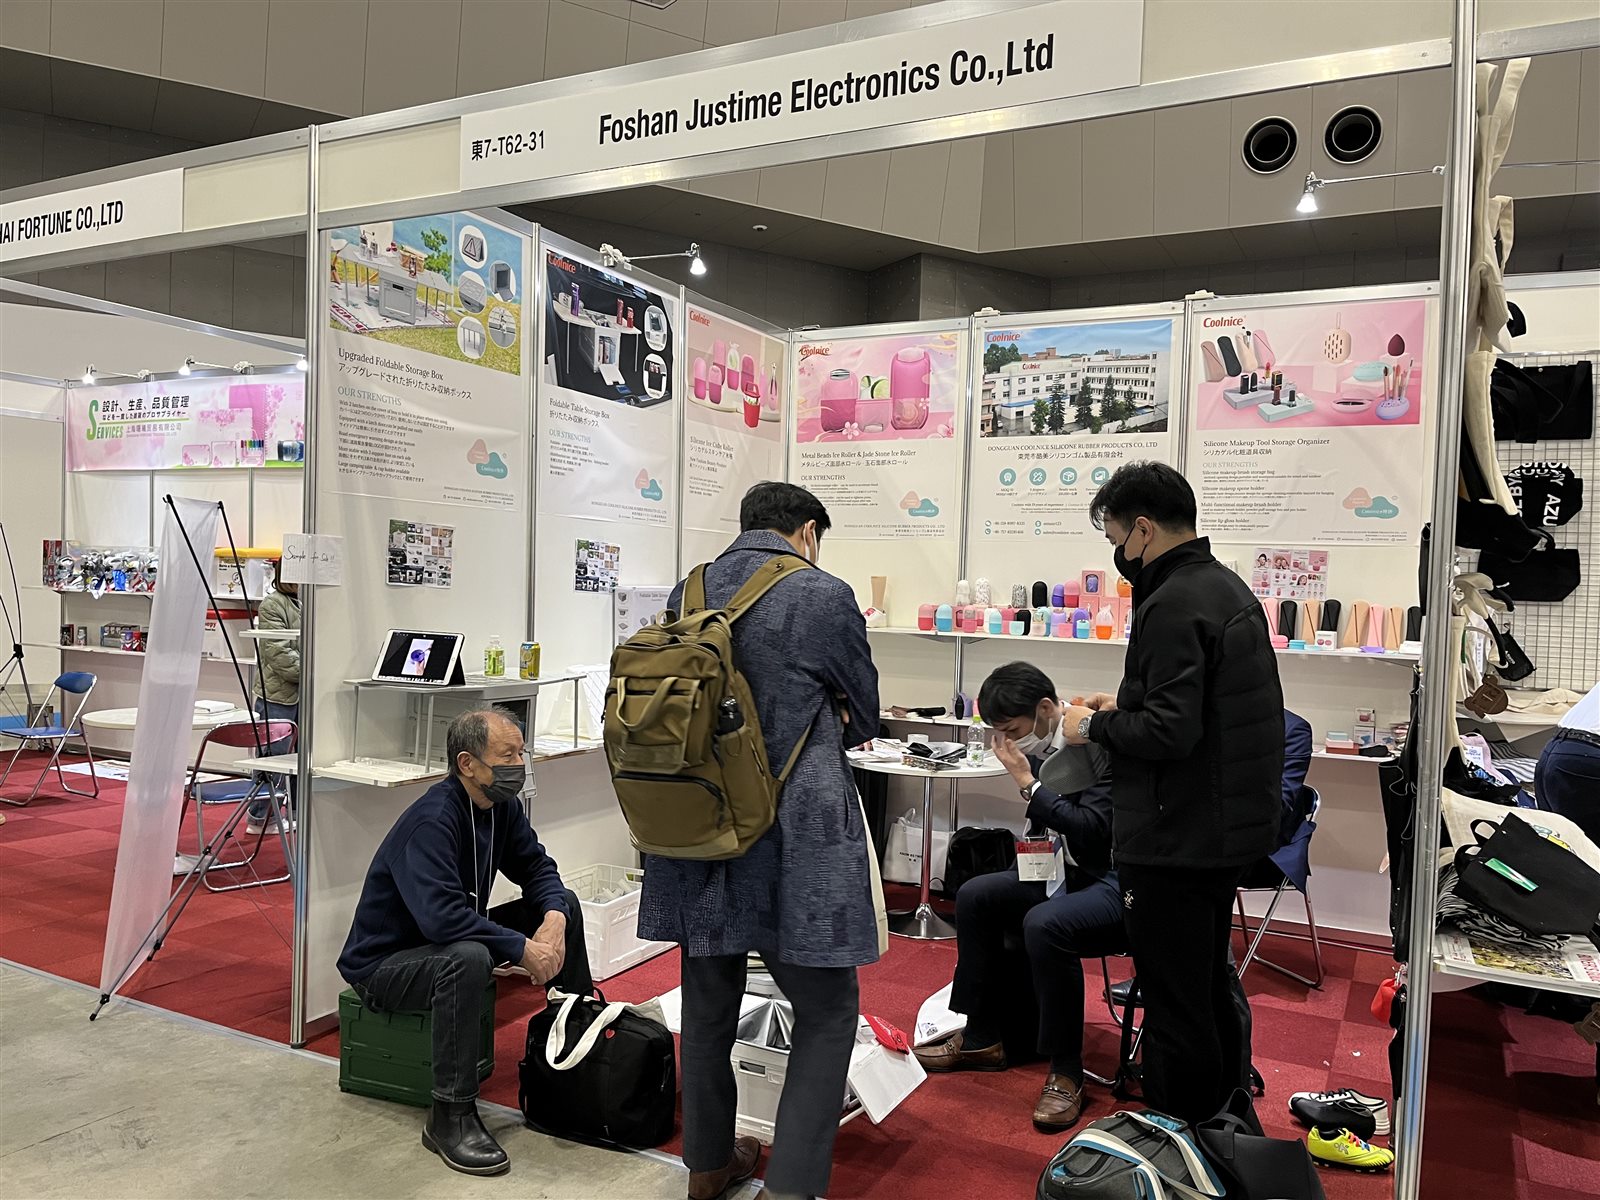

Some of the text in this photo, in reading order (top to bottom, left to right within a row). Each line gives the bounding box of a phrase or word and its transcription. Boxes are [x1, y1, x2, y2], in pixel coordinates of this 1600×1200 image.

[599, 33, 1055, 145] Foshan Justime Electronics Co.,Ltd
[471, 130, 546, 161] 東7-T62-31
[18, 209, 73, 241] FORTUNE
[75, 200, 124, 232] CO.,LTD
[548, 252, 577, 274] Coolnice
[689, 310, 711, 327] Coolnice
[1203, 316, 1244, 329] Coolnice
[986, 332, 1021, 343] Coolnice
[799, 344, 831, 359] Coolnice
[338, 347, 444, 381] Upgraded Foldable Storage Box
[337, 385, 402, 406] OUR STRENGTHS
[549, 397, 610, 420] Foldable Table Storage Box
[86, 399, 124, 441] SERVICES
[548, 428, 591, 443] OUR STRENGTHS
[1229, 440, 1255, 448] Makeup
[1271, 439, 1296, 447] Storage
[1296, 438, 1330, 447] Organizer
[862, 451, 874, 459] Jade
[1542, 493, 1562, 527] AZU
